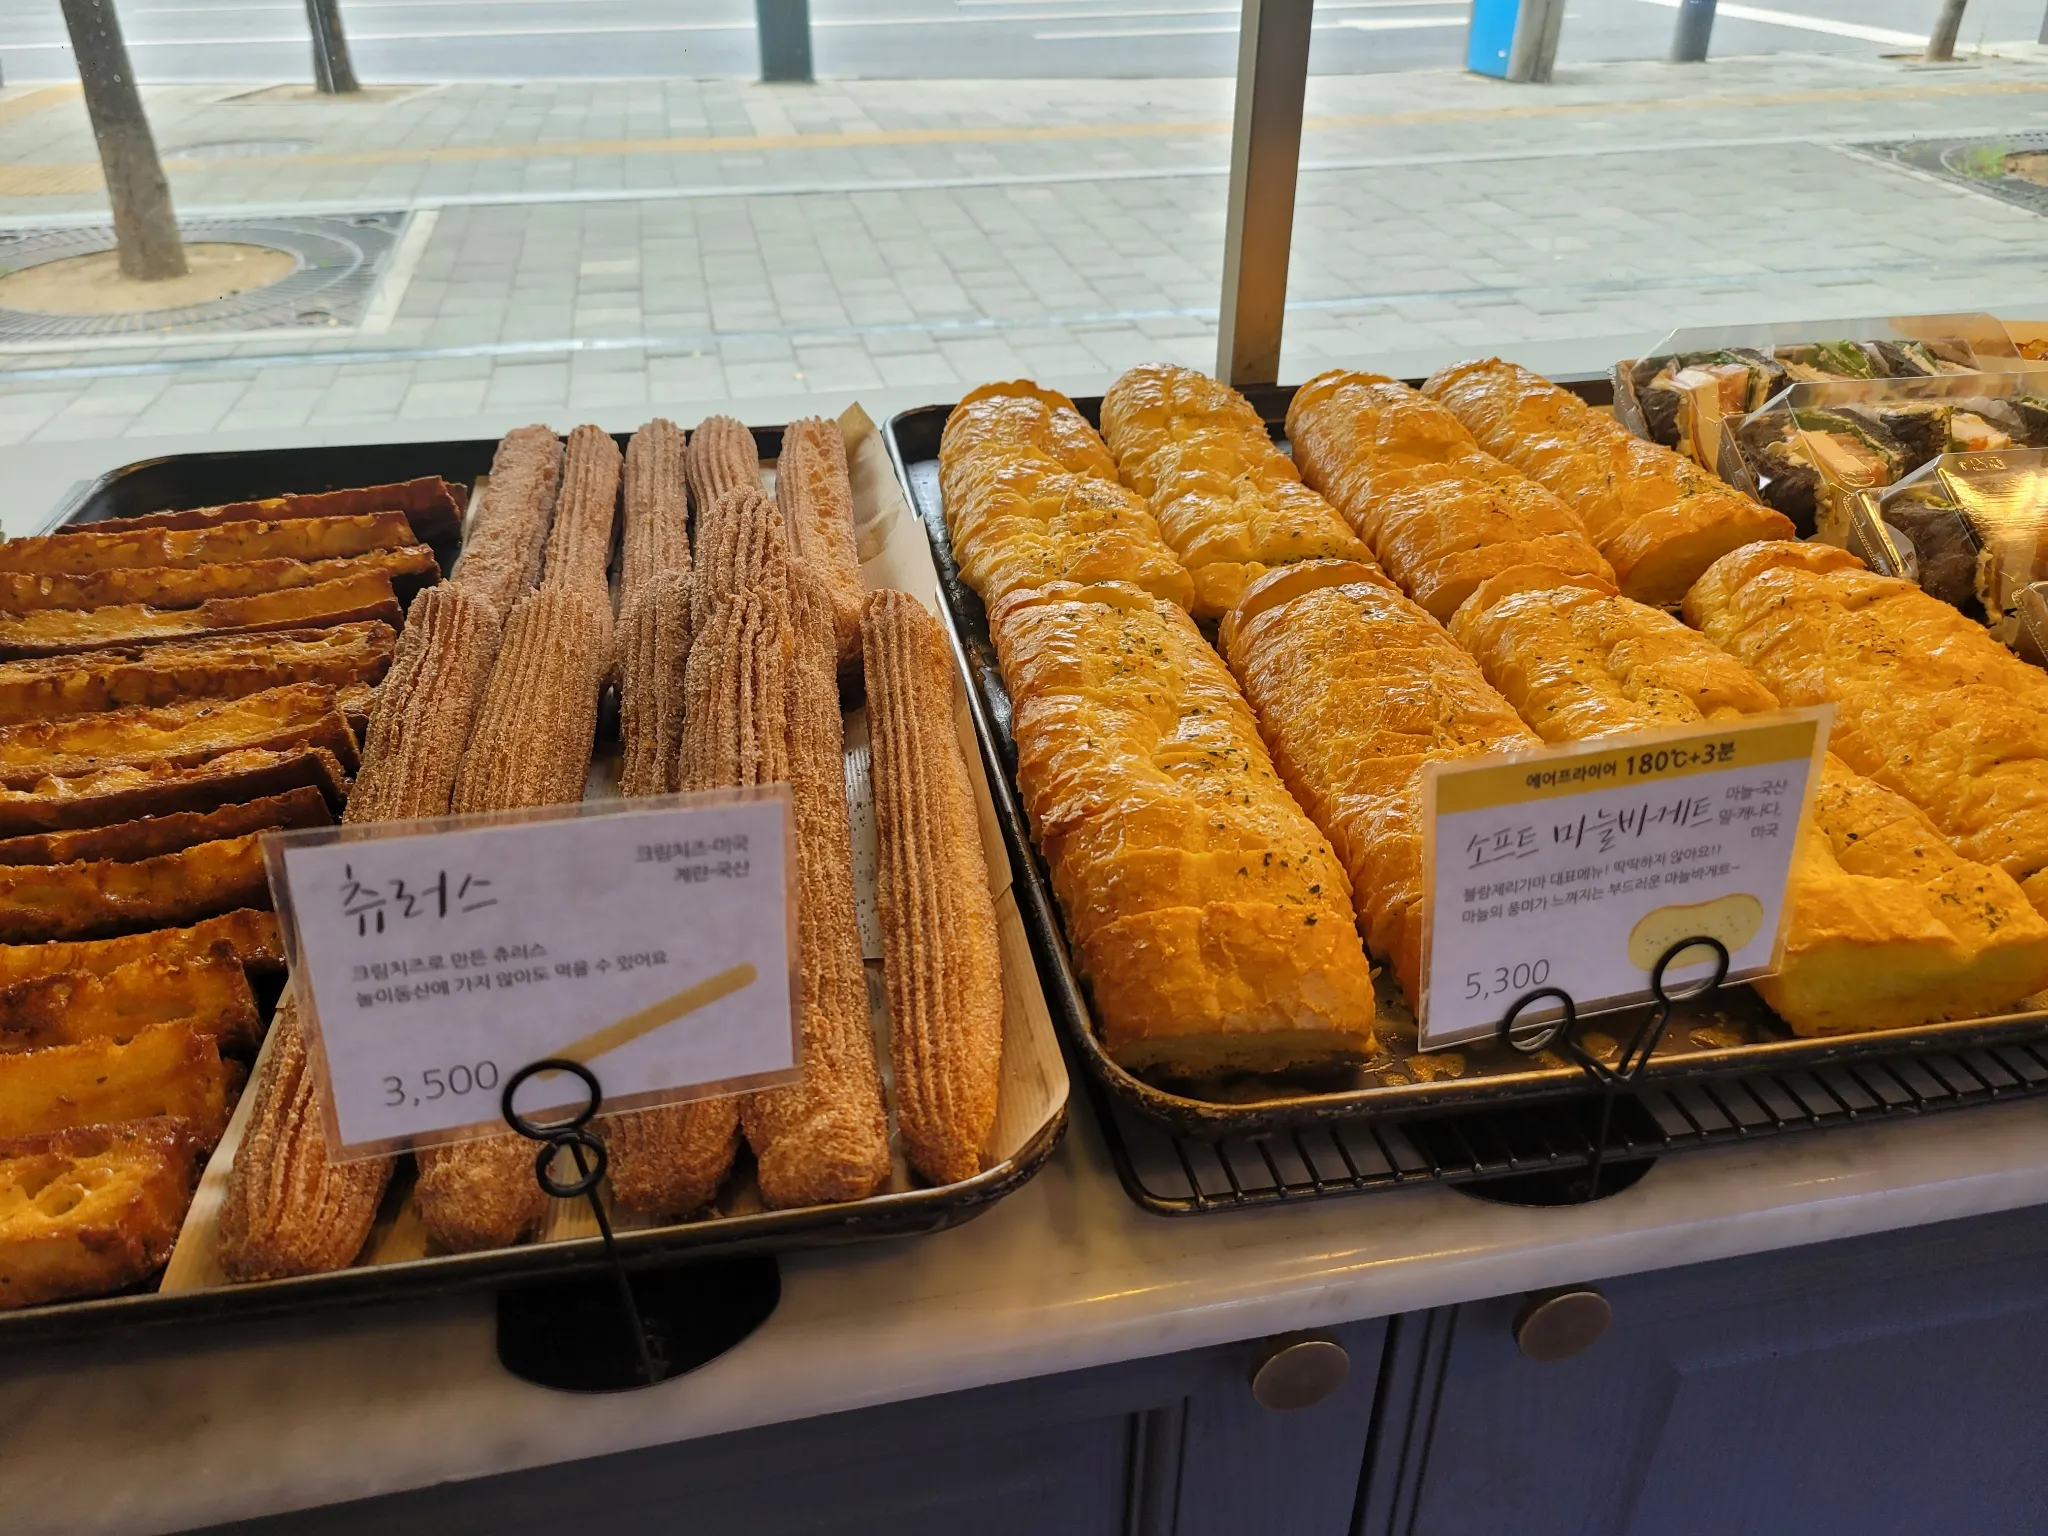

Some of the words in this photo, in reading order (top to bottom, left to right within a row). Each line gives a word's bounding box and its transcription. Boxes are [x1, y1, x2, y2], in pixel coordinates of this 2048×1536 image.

[1525, 760, 1618, 790] 에어프라이어
[1466, 825, 1541, 870] 소프트
[1552, 795, 1714, 855] 마늘바게트
[1750, 823, 1779, 840] 미국
[1463, 874, 1546, 904] 블랑제리가마
[1550, 864, 1611, 888] 대표메뉴!
[1613, 852, 1667, 877] 딱딱하지
[1669, 843, 1723, 867] 않아요!!
[341, 863, 499, 938] 츄러스
[1461, 901, 1503, 924] 마늘의
[1506, 895, 1548, 917] 풍미가
[1550, 883, 1605, 908] 느껴지는
[1608, 874, 1661, 897] 부드러운
[351, 955, 446, 984] 크림치즈로
[449, 949, 488, 971] 만든
[492, 940, 548, 964] 츄러스
[354, 976, 452, 1009] 놀이동산에
[455, 968, 493, 992] 가지
[496, 962, 552, 989] 않아도
[554, 958, 591, 979] 먹을
[593, 955, 612, 974] 수
[615, 948, 669, 972] 있어요
[1464, 959, 1551, 1001] 5,300
[383, 1061, 499, 1107] 3,500
